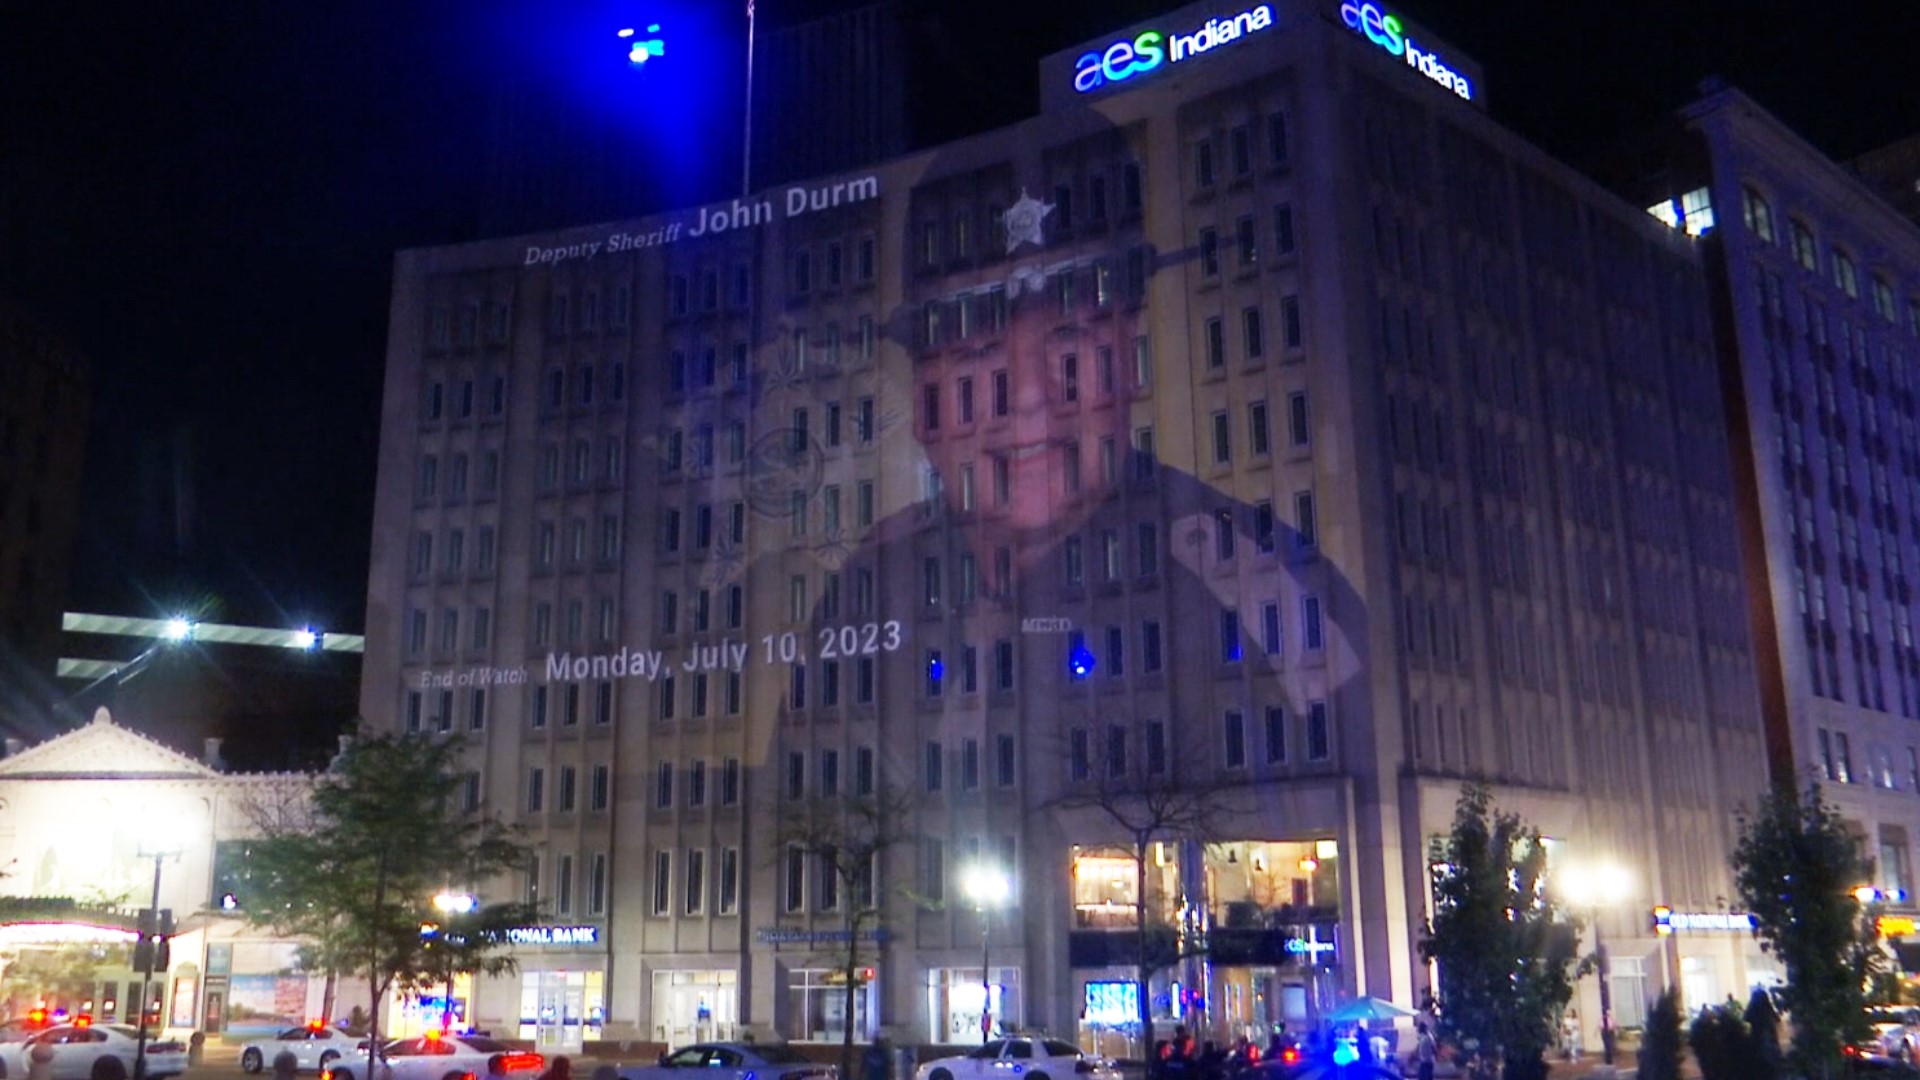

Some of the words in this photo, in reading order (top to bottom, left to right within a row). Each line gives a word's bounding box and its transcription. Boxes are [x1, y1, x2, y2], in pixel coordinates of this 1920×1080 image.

[1074, 31, 1165, 92] aes
[1168, 5, 1272, 63] Indiana
[1341, 0, 1404, 56] aes
[1404, 37, 1471, 100] Indiana
[523, 241, 601, 267] Deputy
[606, 222, 683, 253] Sheriff
[689, 199, 773, 238] John
[786, 174, 879, 217] Durm
[420, 670, 454, 689] End
[457, 669, 475, 687] of
[480, 665, 528, 685] Watch
[545, 645, 672, 682] Monday,
[682, 637, 748, 672] July
[762, 631, 807, 666] 10,
[819, 619, 902, 660] 2023
[552, 927, 596, 943] BANK
